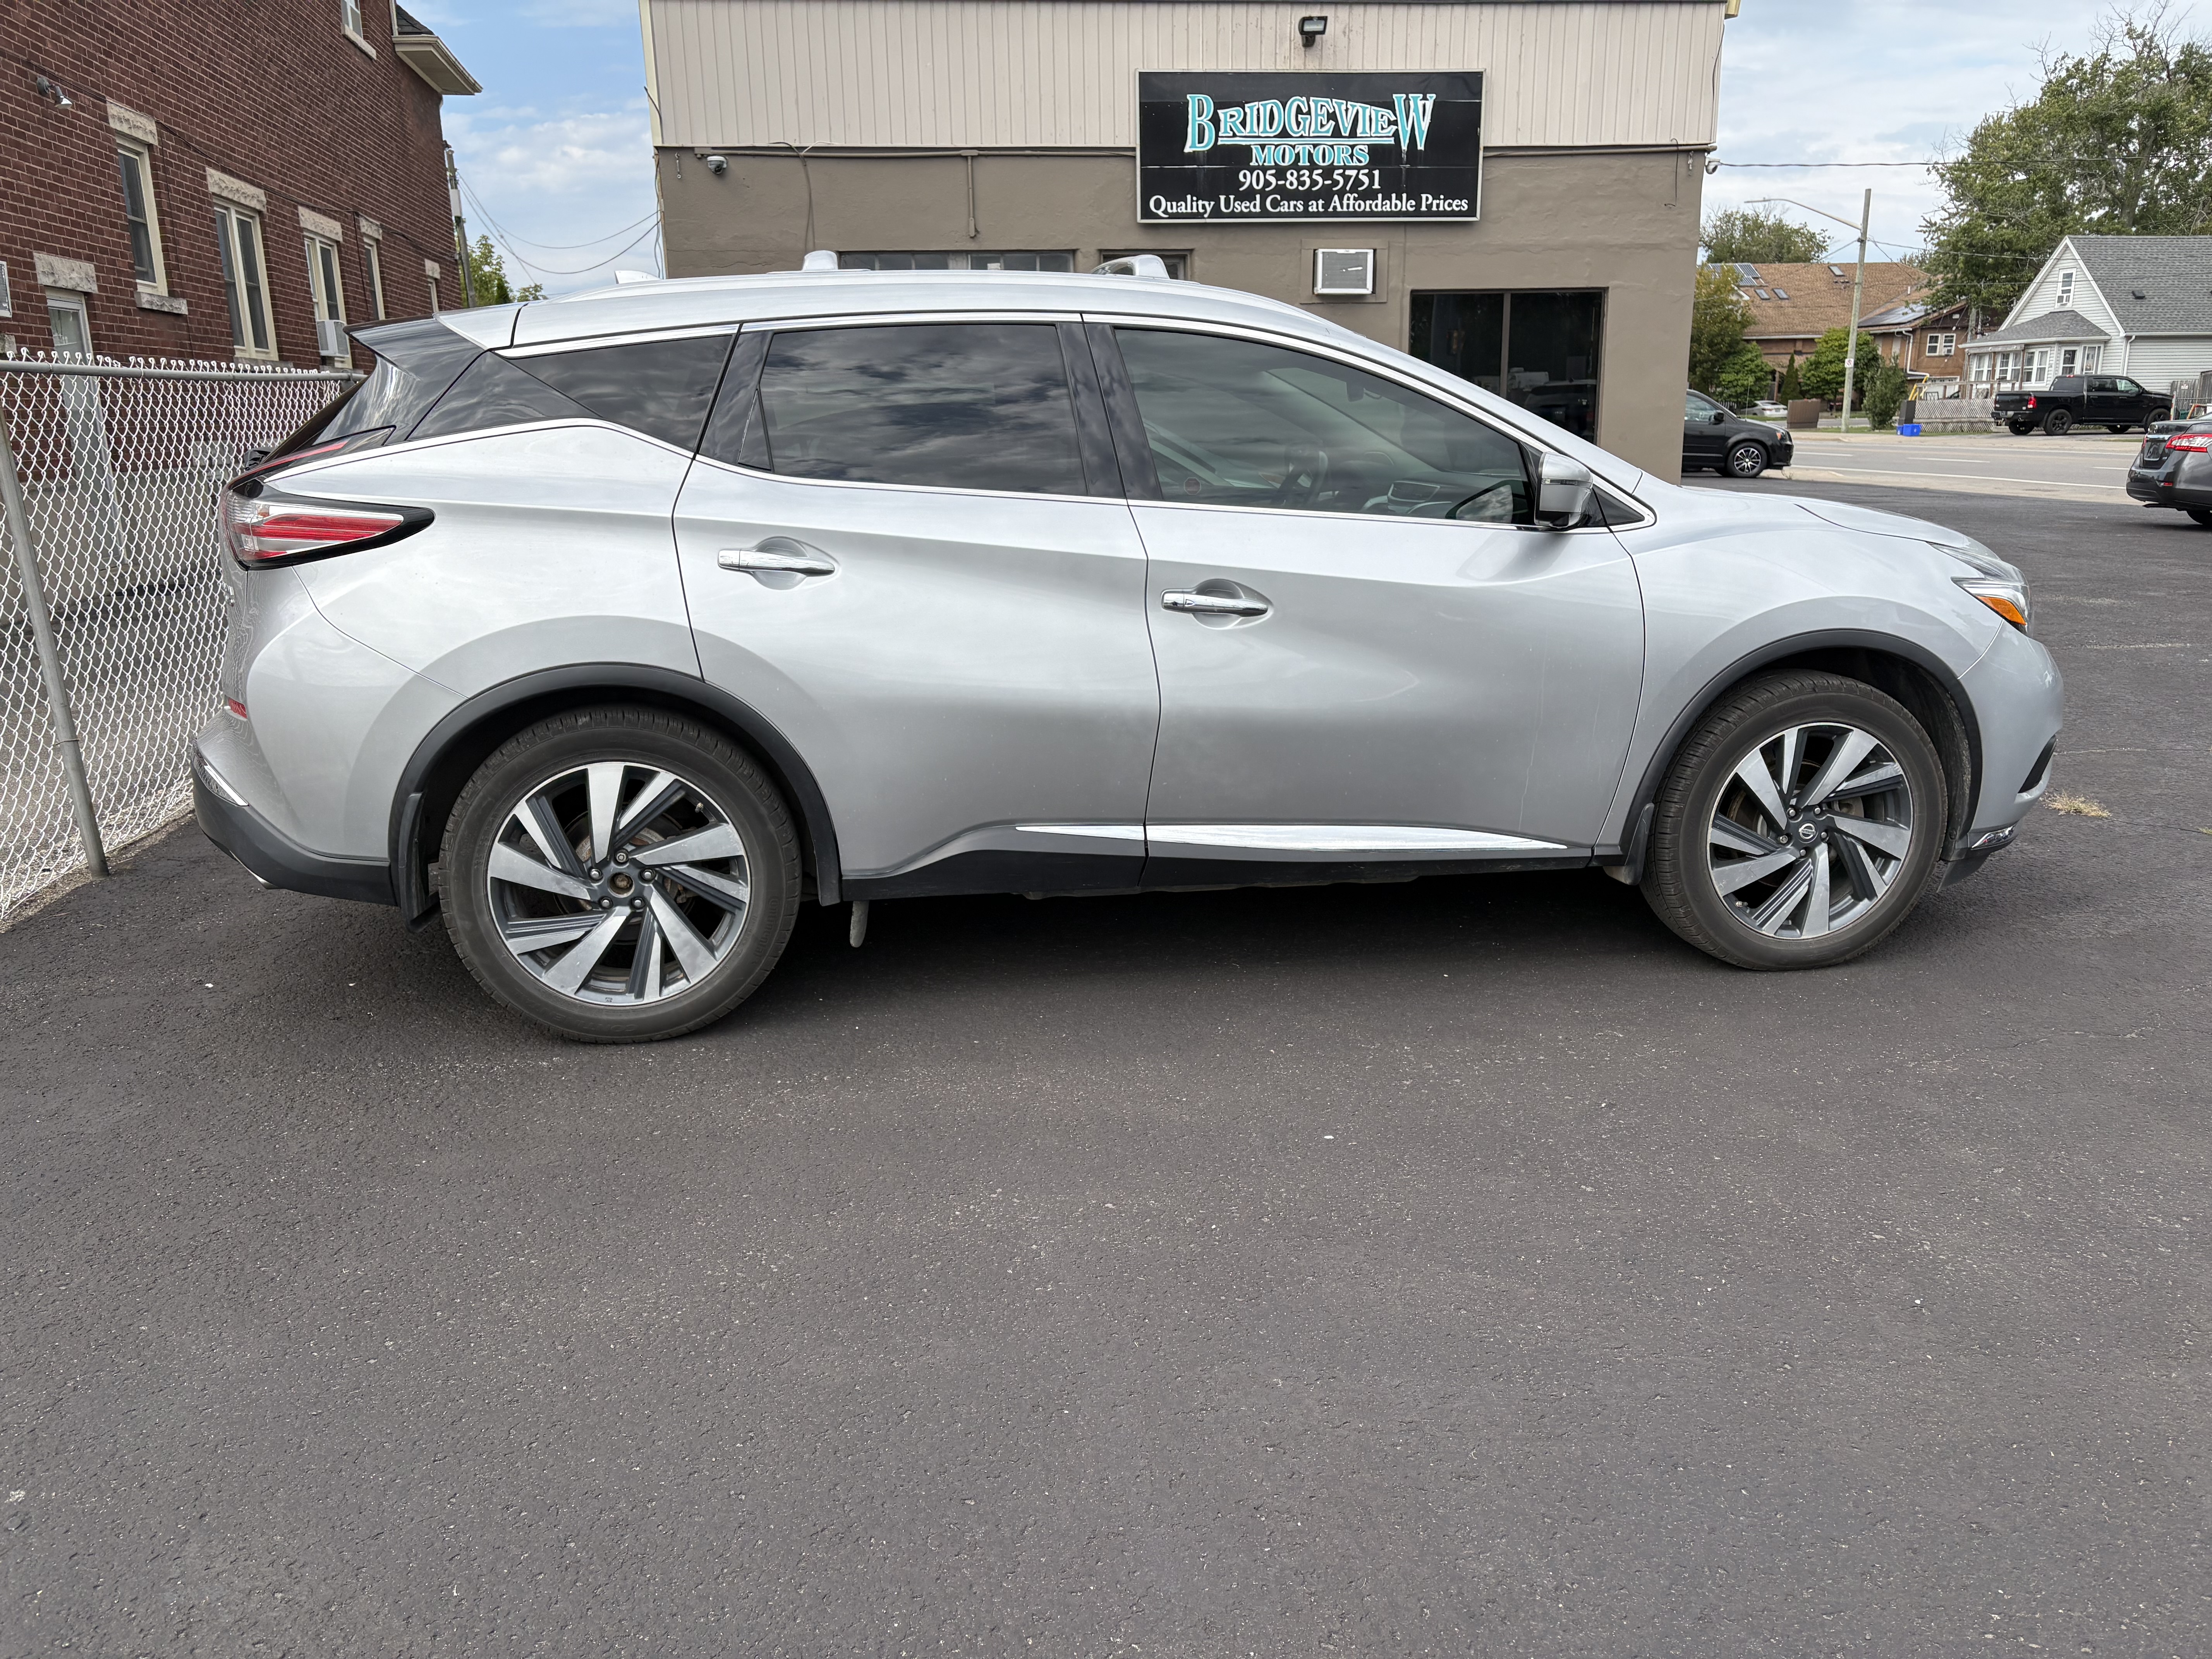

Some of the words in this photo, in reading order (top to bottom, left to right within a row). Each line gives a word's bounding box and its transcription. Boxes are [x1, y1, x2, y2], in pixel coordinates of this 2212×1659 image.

[1183, 94, 1436, 152] BRIDGEVIEW
[1250, 145, 1369, 166] MOTORS
[1239, 169, 1381, 191] 905-835-5751
[1149, 194, 1215, 218] Quality
[1219, 194, 1261, 213] Used
[1266, 195, 1304, 212] Cars
[1308, 198, 1325, 212] at
[1327, 193, 1416, 212] Affordable
[1420, 194, 1468, 211] Prices
